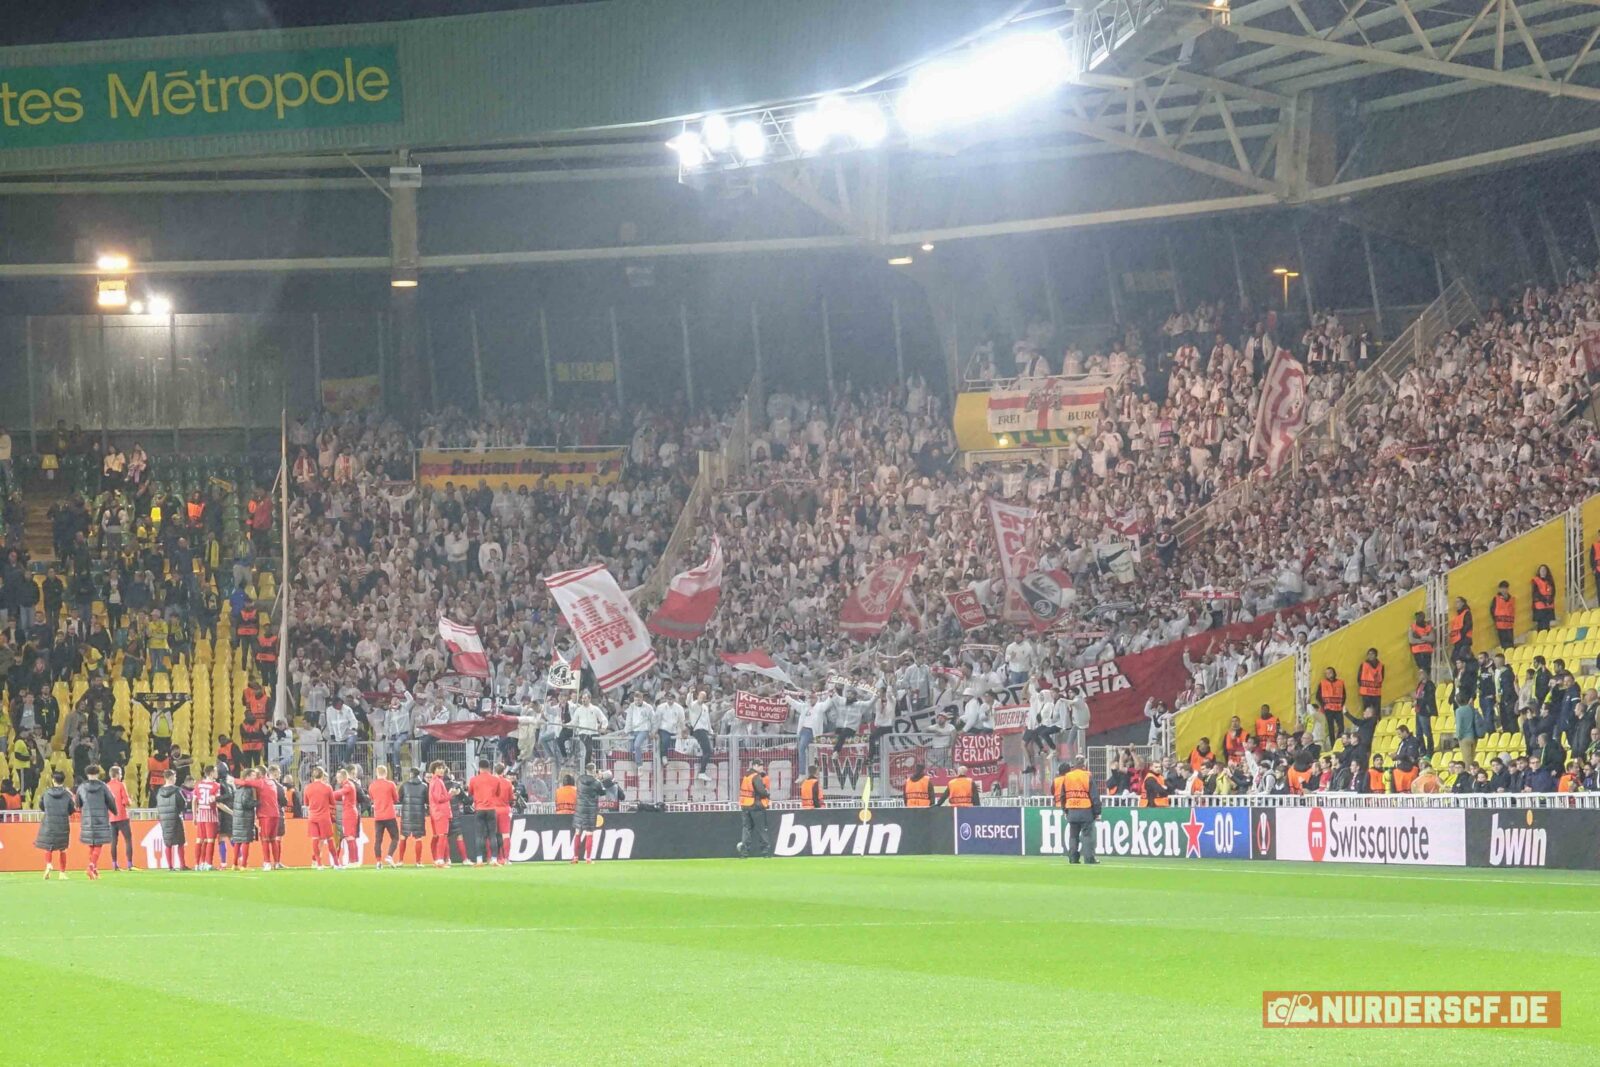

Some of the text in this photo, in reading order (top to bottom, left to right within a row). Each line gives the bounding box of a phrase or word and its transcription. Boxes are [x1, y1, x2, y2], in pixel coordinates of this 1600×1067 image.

[998, 410, 1098, 425] FREI BURG
[1054, 661, 1119, 690] UEFA
[954, 733, 1000, 749] SEZIONE
[954, 746, 1000, 761] BERLINO
[508, 815, 636, 862] bwin
[774, 809, 902, 856] bwin
[975, 825, 1019, 839] RESPECT
[1330, 811, 1429, 864] Swissquote
[1489, 809, 1547, 866] bwin
